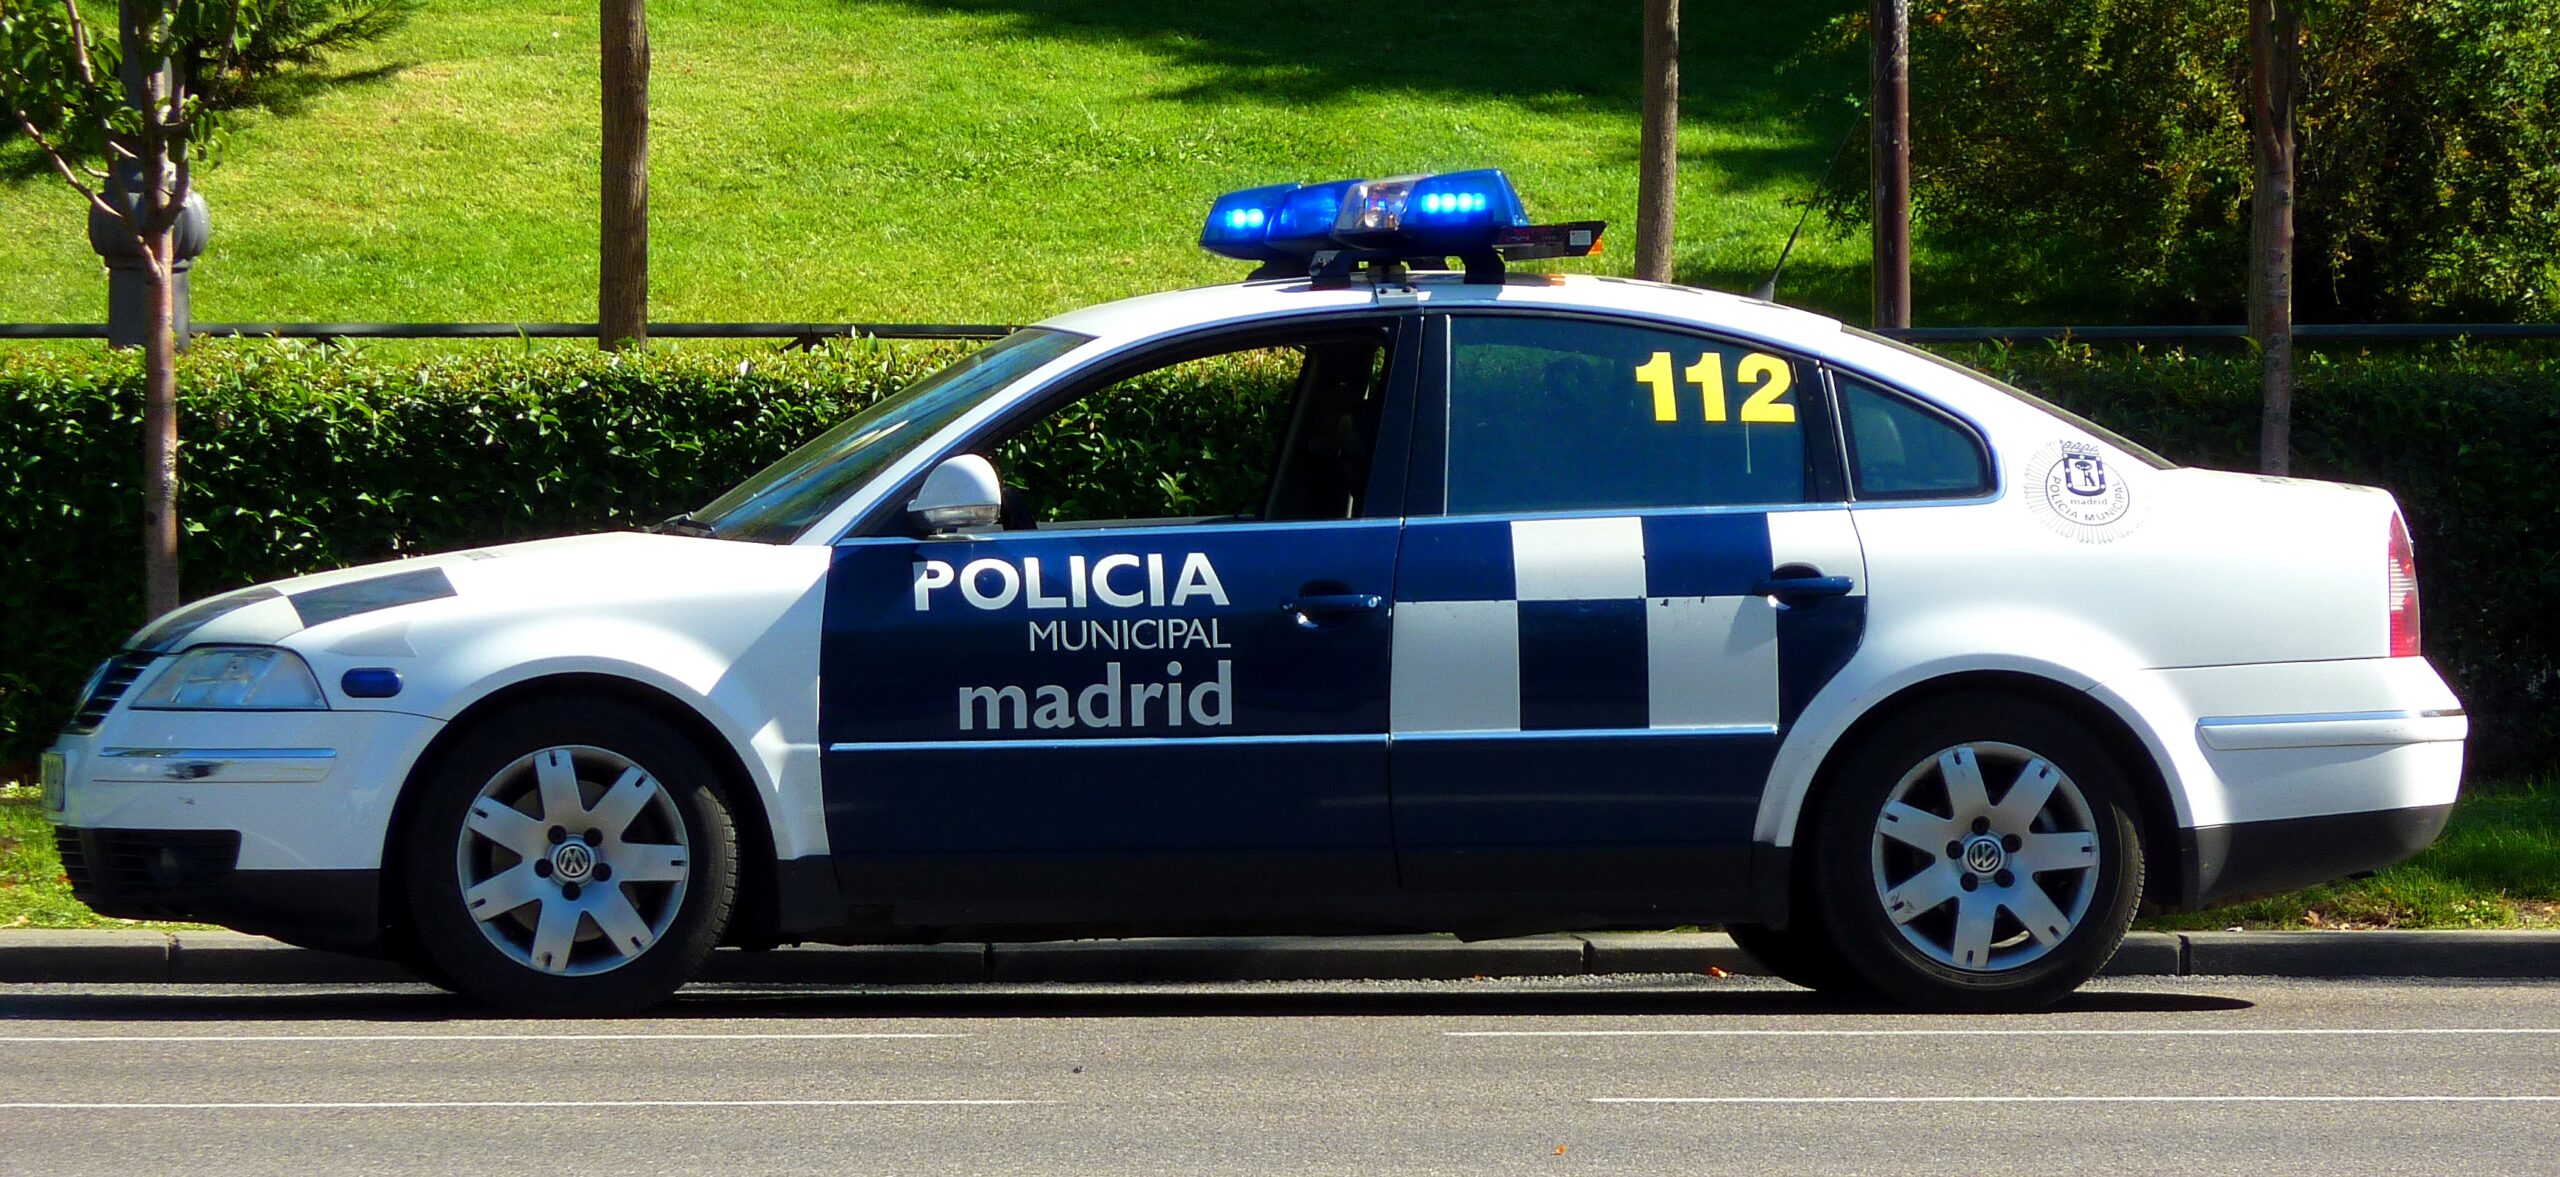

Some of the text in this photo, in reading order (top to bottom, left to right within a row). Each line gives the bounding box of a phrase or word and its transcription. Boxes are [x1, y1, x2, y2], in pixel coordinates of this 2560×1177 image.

[1635, 351, 1796, 423] 112
[2050, 475, 2125, 521] POLICIA MUNICIPAL
[913, 552, 1230, 611] POLICIA
[1029, 618, 1231, 652] MUNICIPAL
[959, 660, 1232, 730] madrid
